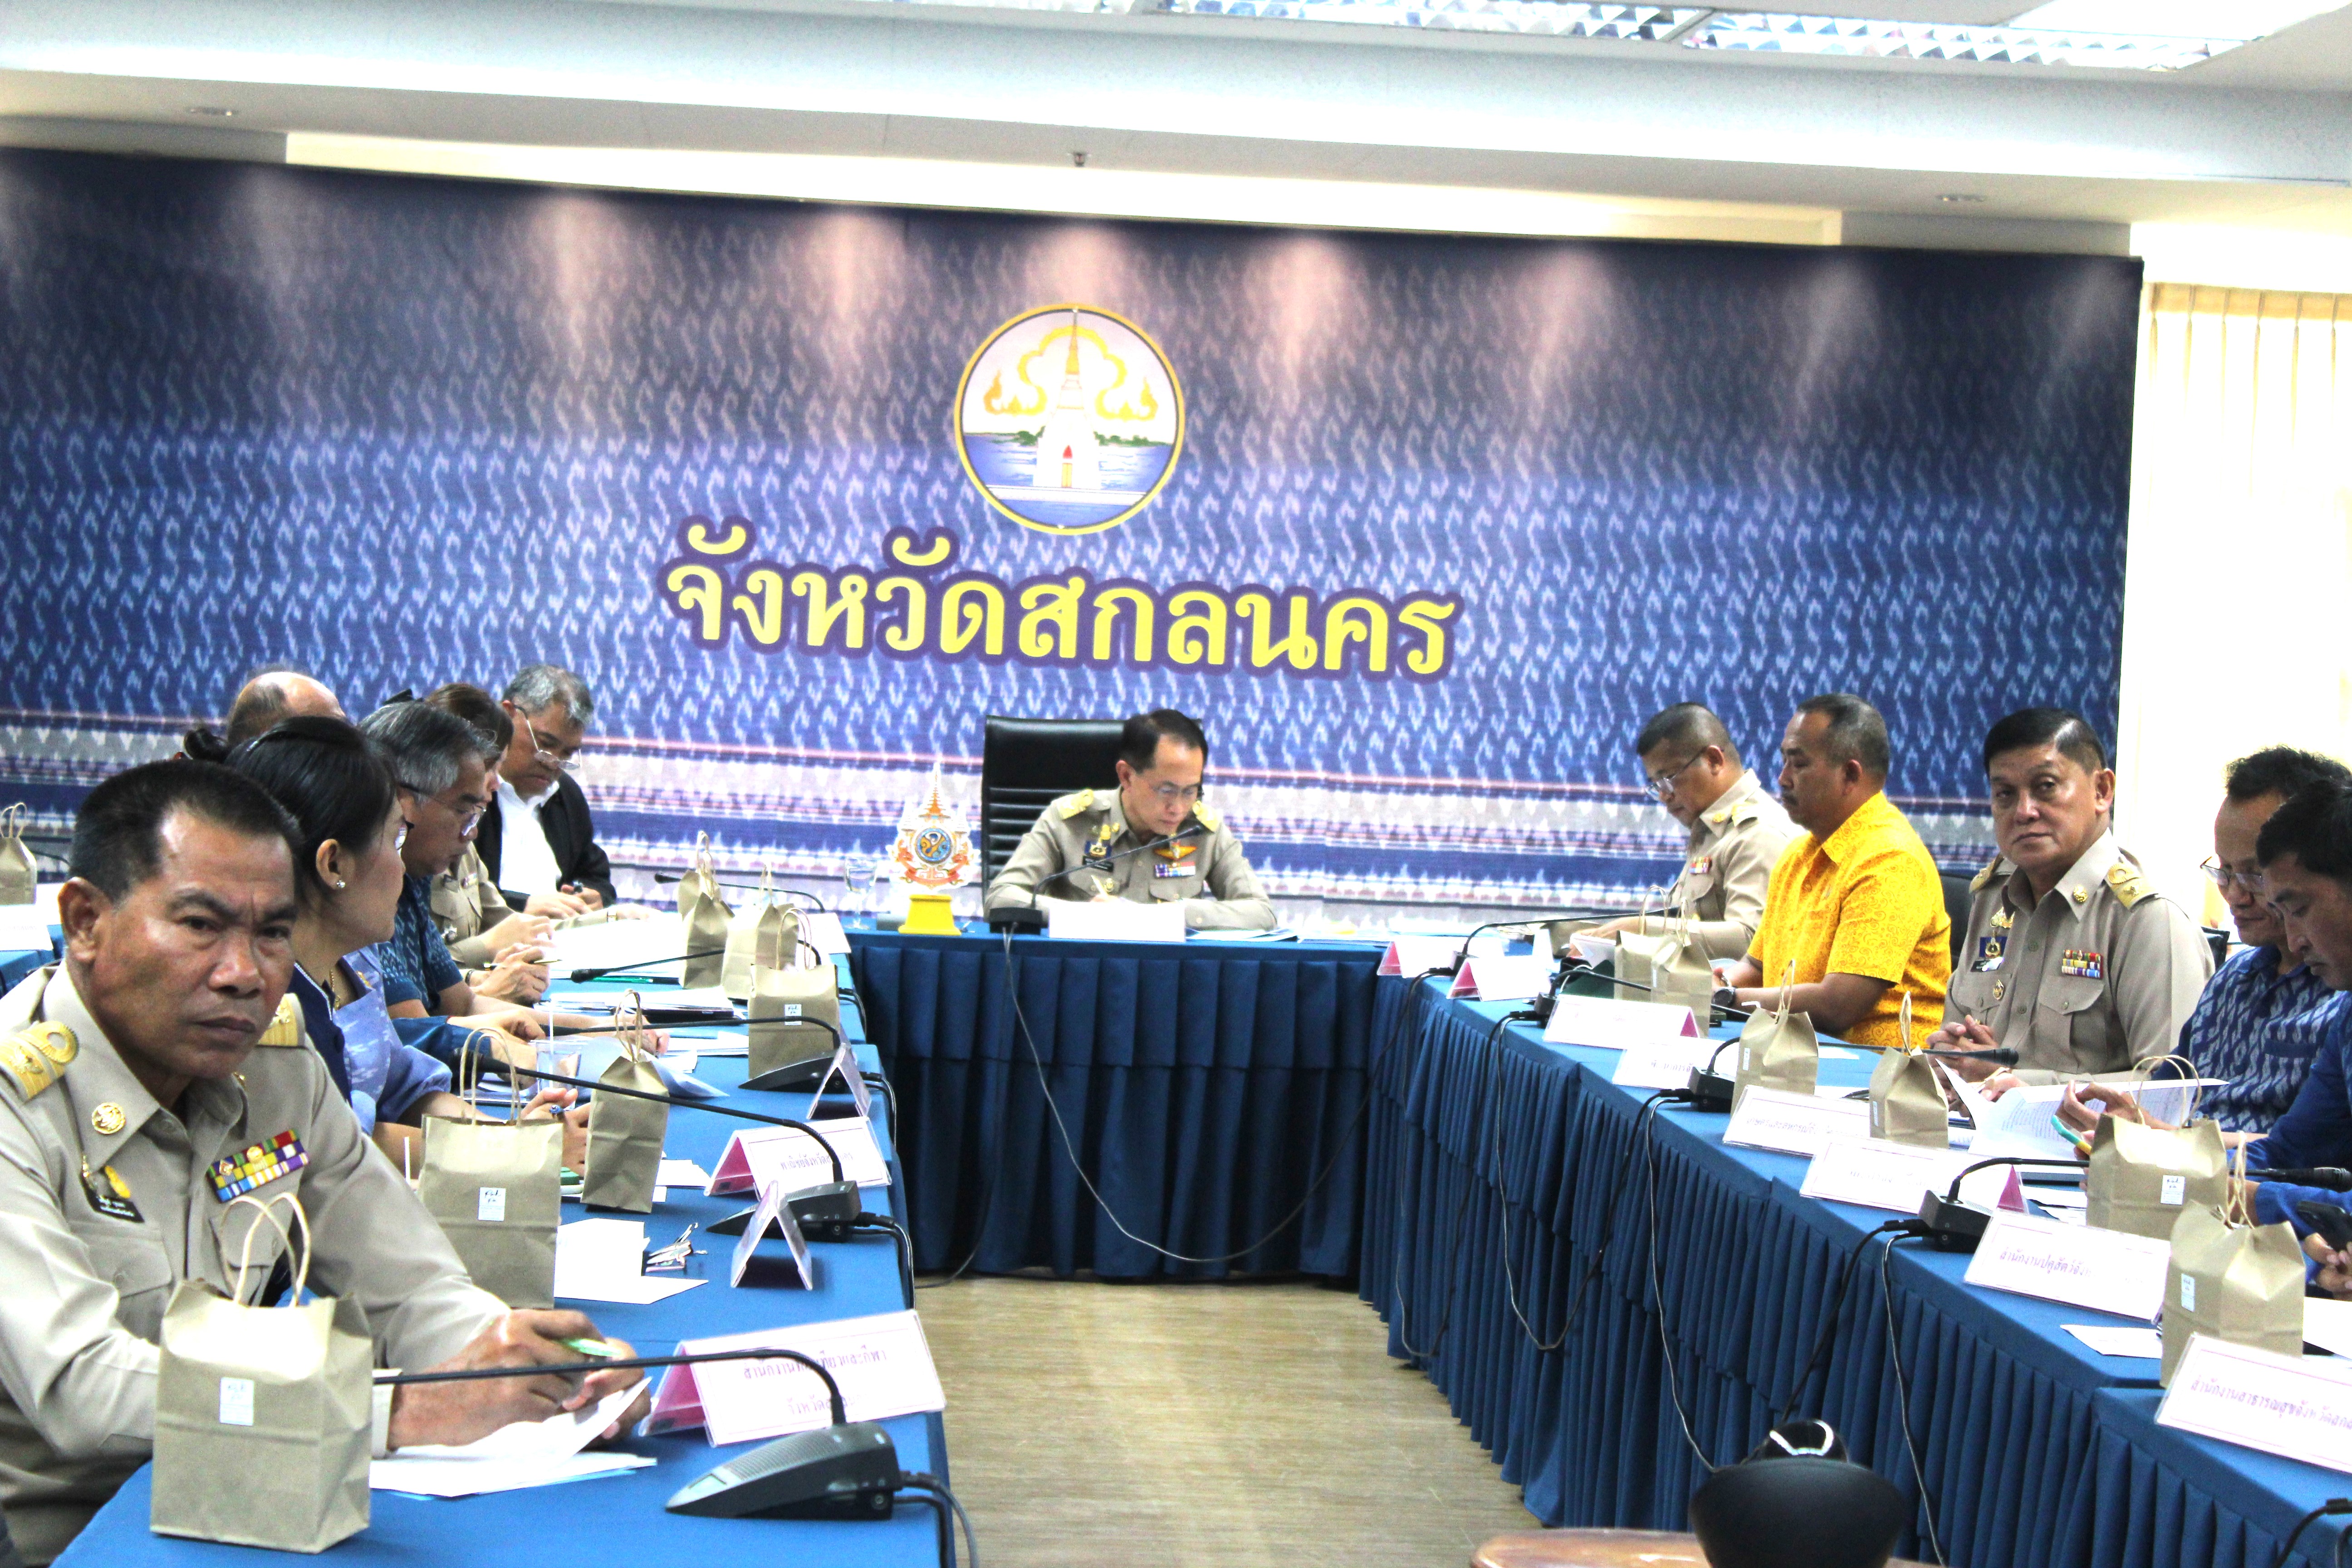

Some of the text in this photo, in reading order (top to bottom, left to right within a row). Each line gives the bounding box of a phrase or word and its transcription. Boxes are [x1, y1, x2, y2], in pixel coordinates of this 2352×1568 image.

[668, 524, 1454, 673] จังหวัดสกลนคร
[780, 1152, 853, 1171] พาณิชย์จังหวัดสนคร
